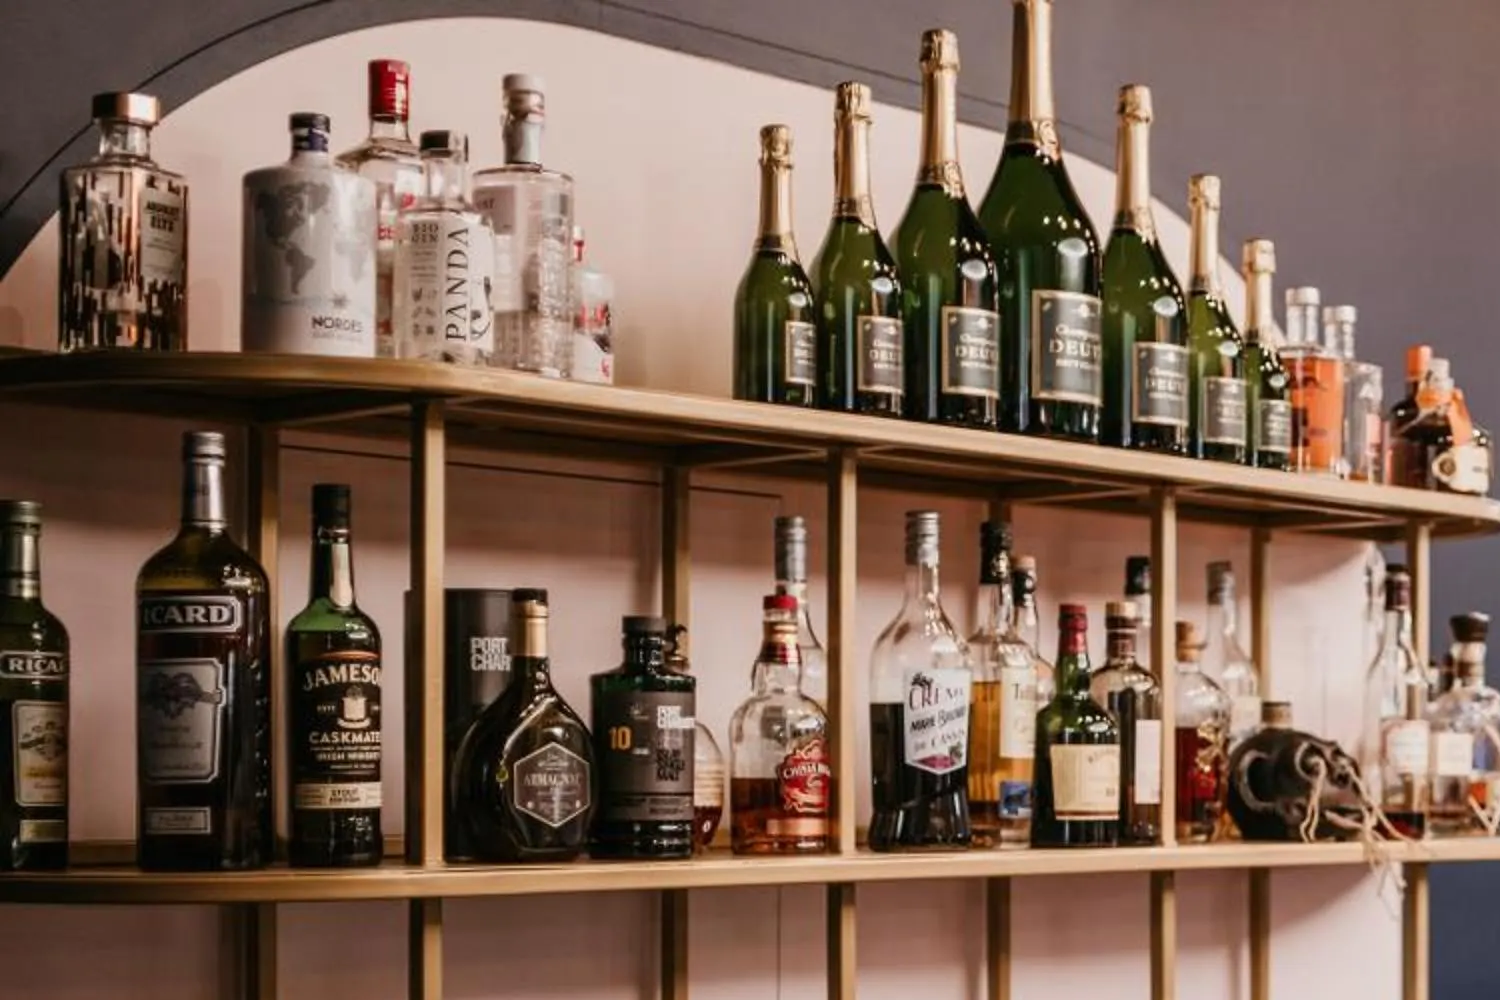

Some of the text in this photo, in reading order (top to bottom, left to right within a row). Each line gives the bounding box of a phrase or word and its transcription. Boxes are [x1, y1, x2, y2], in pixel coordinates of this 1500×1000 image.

[446, 228, 469, 341] PANDA
[470, 637, 508, 655] PORT
[609, 726, 632, 750] 10
